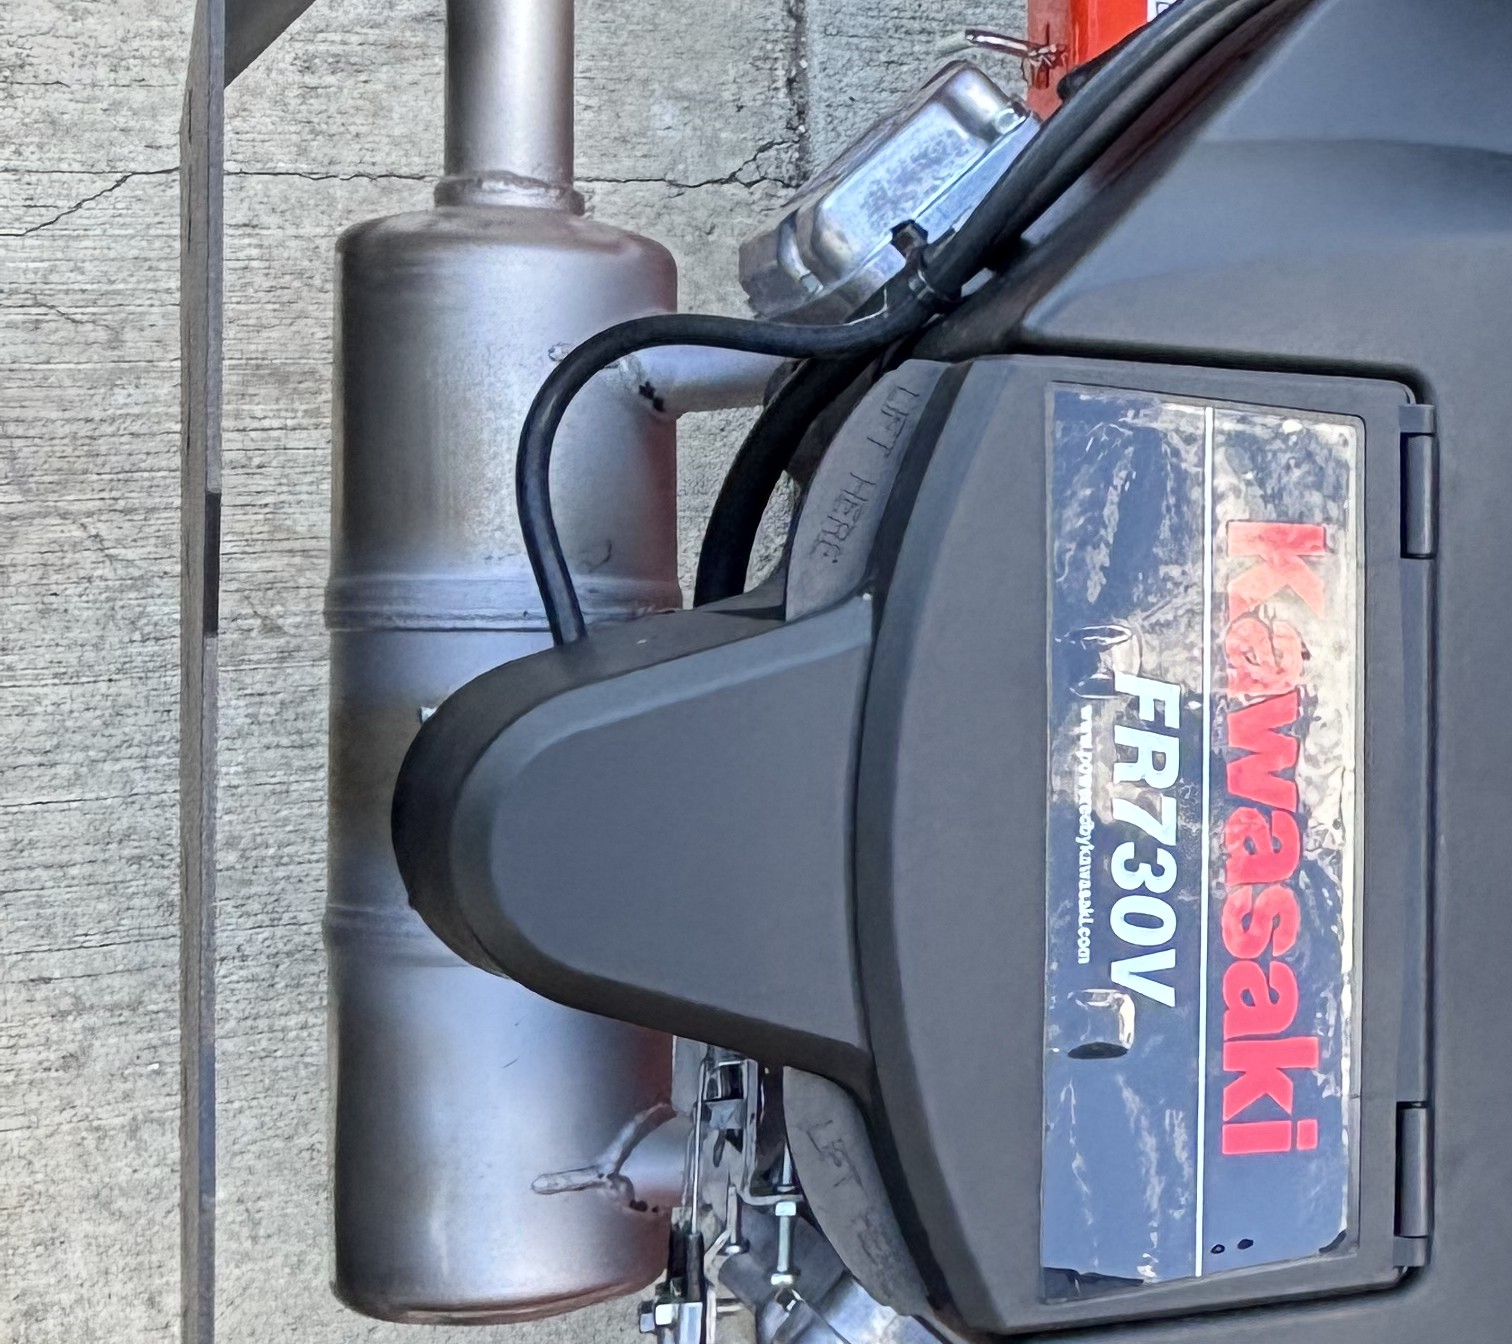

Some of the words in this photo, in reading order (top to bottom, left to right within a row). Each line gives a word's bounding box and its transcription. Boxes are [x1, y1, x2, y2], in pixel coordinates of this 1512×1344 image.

[866, 385, 921, 458] LIFT
[1075, 704, 1095, 965] www.poweredbykawasaki.com
[1109, 673, 1181, 1009] FR730V
[1221, 520, 1327, 1155] Kawasaki
